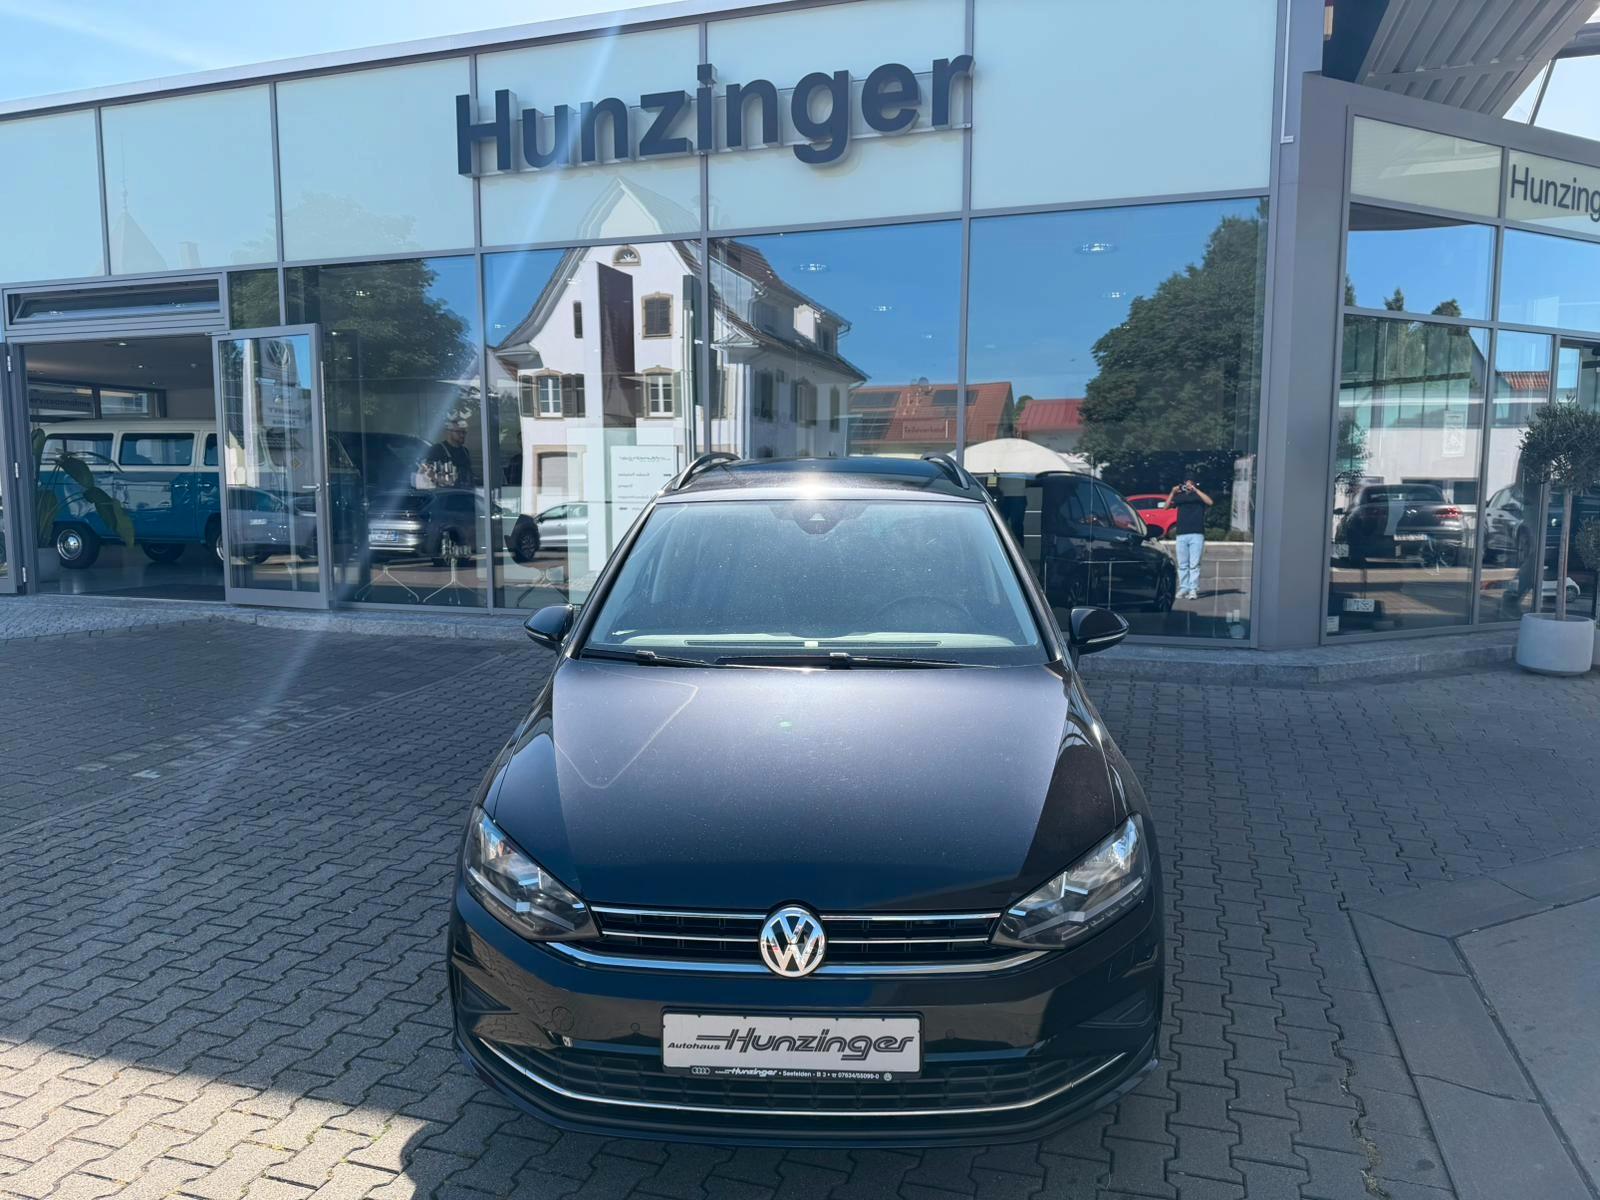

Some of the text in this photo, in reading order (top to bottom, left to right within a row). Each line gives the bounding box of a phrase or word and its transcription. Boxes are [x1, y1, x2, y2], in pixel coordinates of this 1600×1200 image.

[456, 53, 975, 177] Hunzinger
[761, 907, 825, 978] VW
[667, 1027, 915, 1061] Autohaus Hunzinger
